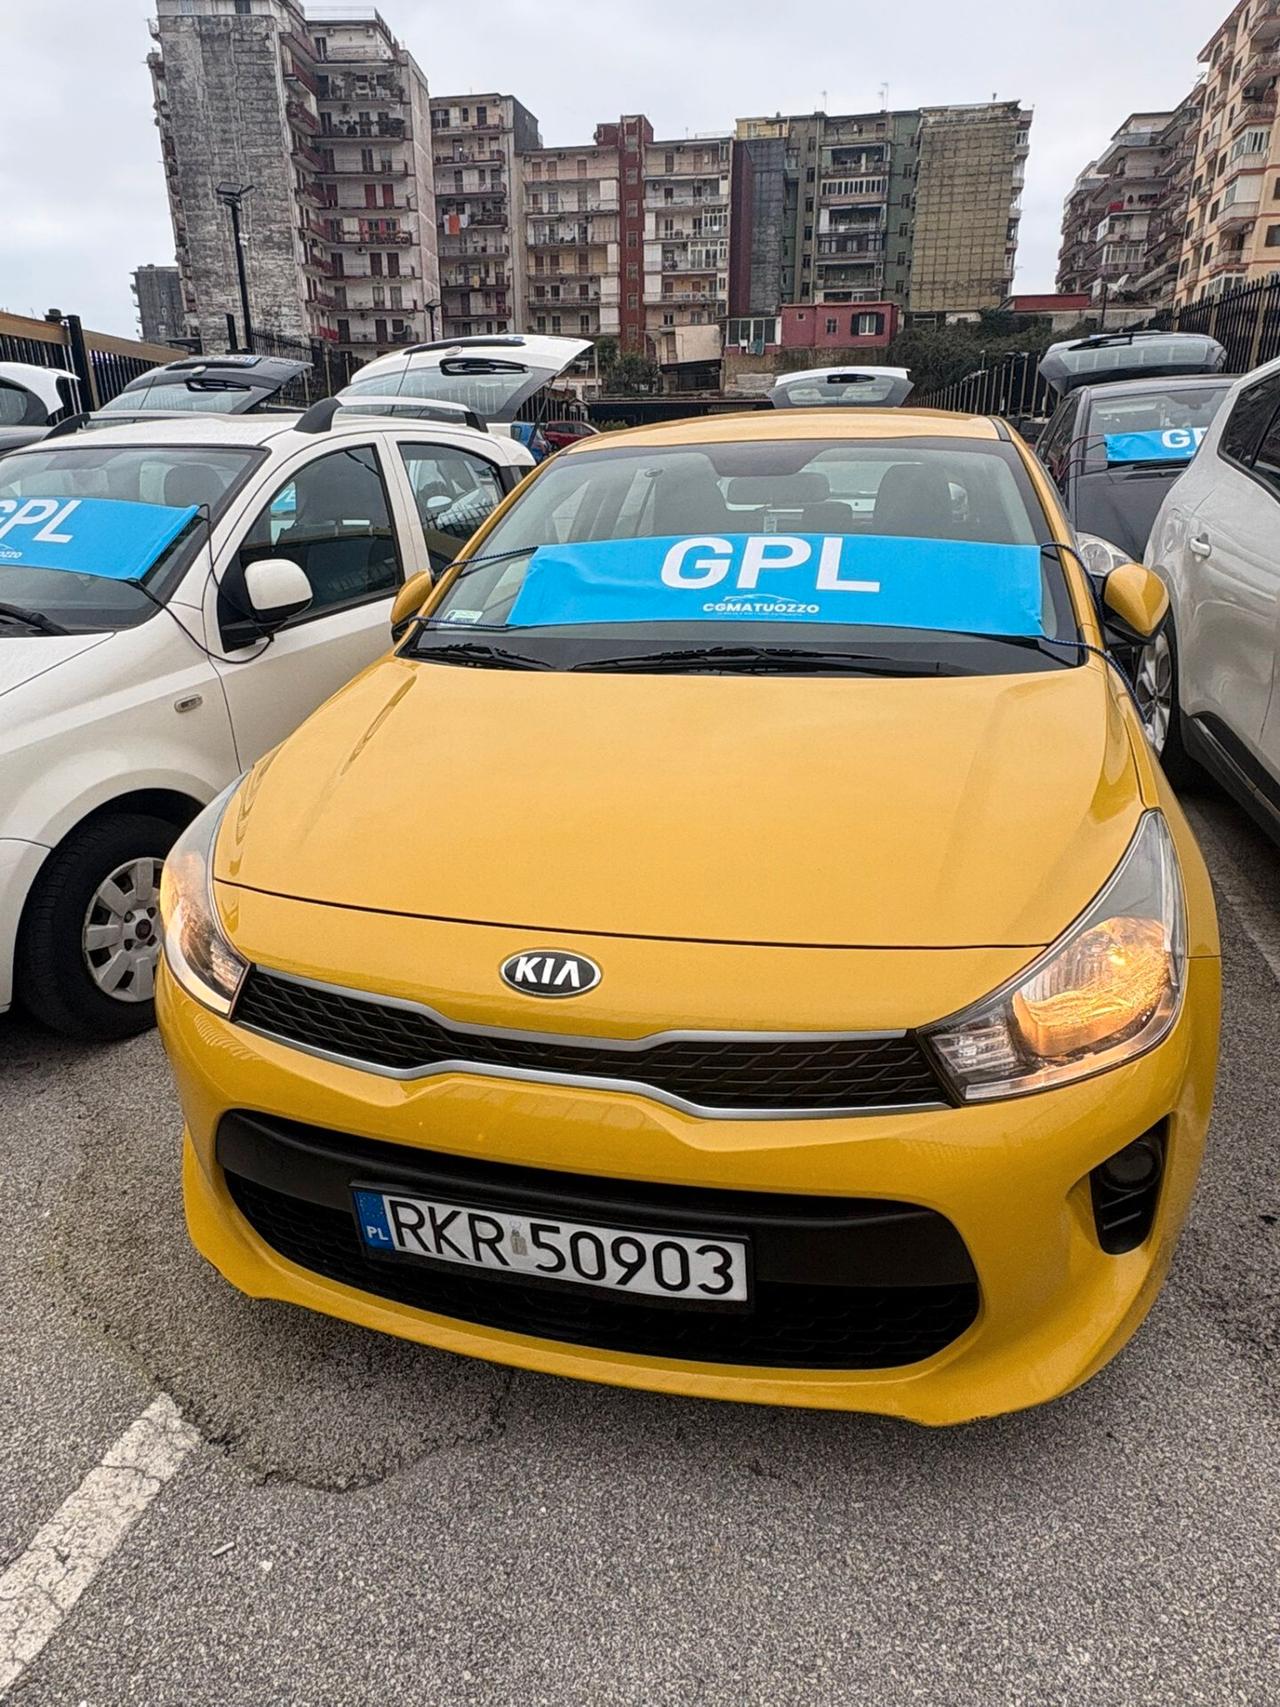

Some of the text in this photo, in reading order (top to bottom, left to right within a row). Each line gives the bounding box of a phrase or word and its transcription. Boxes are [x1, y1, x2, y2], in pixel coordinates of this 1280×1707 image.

[660, 536, 881, 593] GPL
[702, 602, 820, 614] CGMATUOZZO
[514, 956, 580, 988] KIA
[366, 1225, 389, 1240] PL
[388, 1199, 734, 1296] RKR 50903
